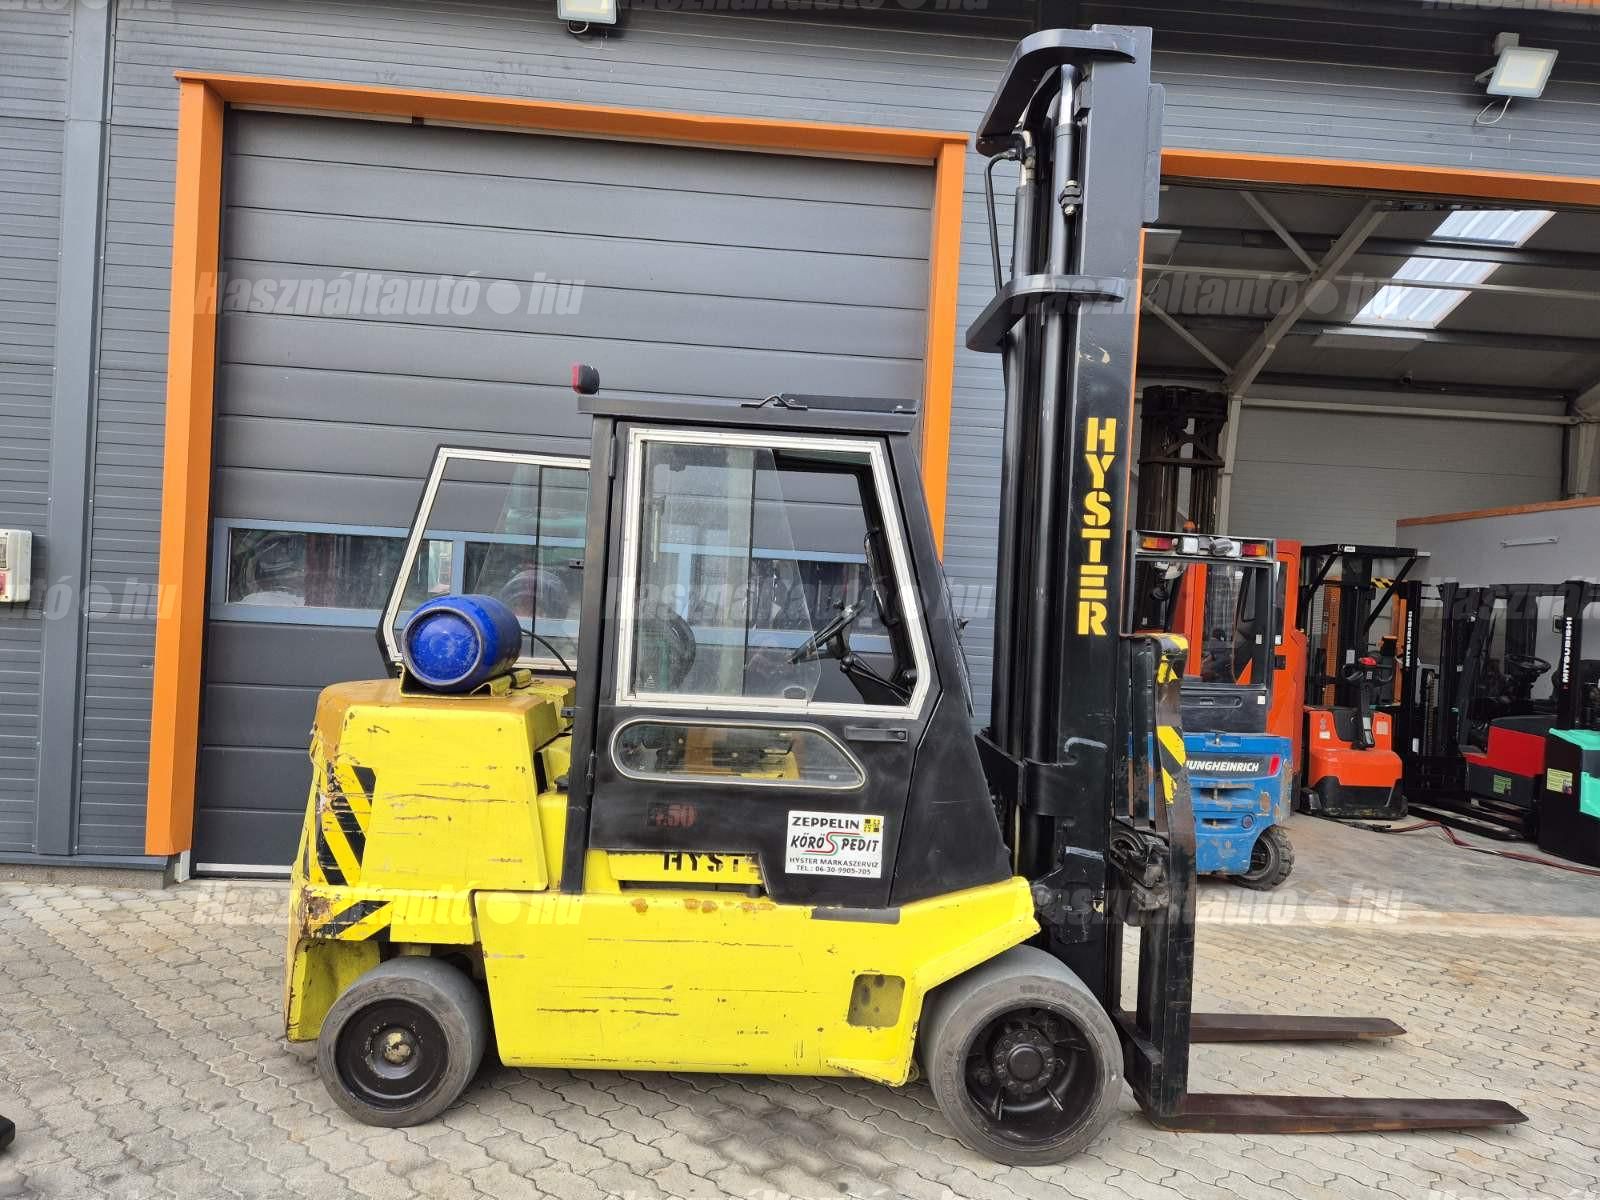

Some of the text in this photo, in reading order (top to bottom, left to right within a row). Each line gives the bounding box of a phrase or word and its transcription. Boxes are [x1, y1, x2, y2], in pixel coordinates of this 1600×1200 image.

[1078, 417, 1116, 635] HYSTER
[1562, 616, 1573, 683] MITSUBISHI
[791, 816, 860, 830] ZEPPELIN
[789, 857, 879, 868] HYSTER MARKASZERVIZ
